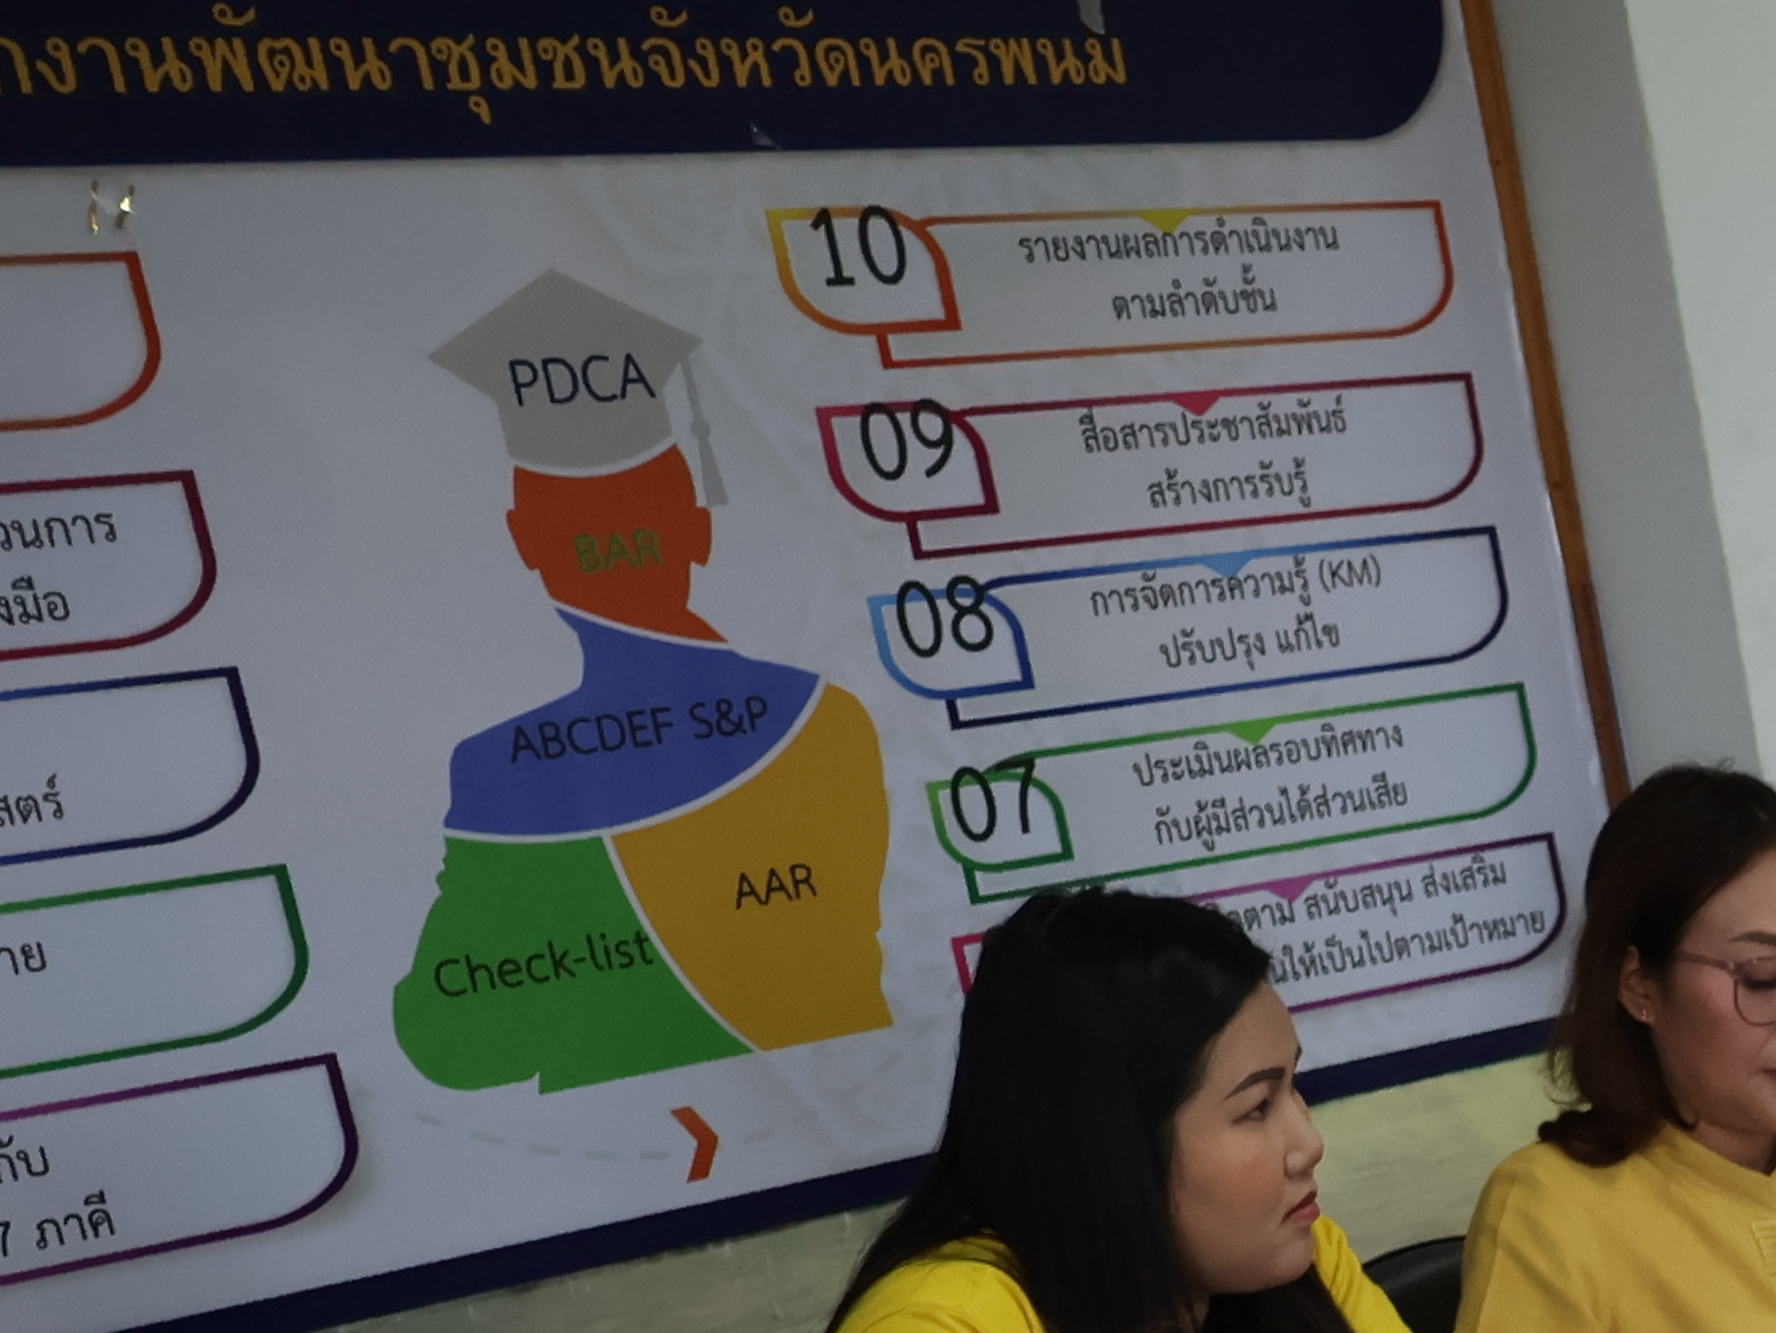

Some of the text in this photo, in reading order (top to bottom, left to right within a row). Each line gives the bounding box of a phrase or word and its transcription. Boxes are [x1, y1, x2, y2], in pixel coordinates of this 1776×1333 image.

[810, 205, 907, 288] 10
[1019, 222, 1339, 266] รายงานผลการดำเนินงาน
[1112, 262, 1278, 322] ตามลำดับชั้น
[508, 353, 656, 408] PDCA
[860, 399, 956, 482] 09
[1082, 397, 1348, 455] สื่อสารประชาสัมพันธ์
[1149, 457, 1312, 509] สร้างการรับรู้
[574, 528, 663, 574] BAR
[896, 575, 994, 660] 08
[1090, 554, 1381, 619] การจัดการความรู้ (KM)
[1160, 616, 1340, 673] ปรับปรุง แก้ไข
[510, 695, 769, 765] ABCDEF S&P
[1133, 720, 1404, 790] ประเมินผลรอบทิศทาง
[950, 757, 1038, 843] 07
[1154, 776, 1409, 852] กับผู้มีส่วนได้ส่วนเสีย
[735, 864, 817, 910] AAR
[1305, 877, 1413, 921] สนับสนุน
[1421, 853, 1507, 900] ส่งเสริม
[434, 930, 654, 999] Check-list
[36, 1190, 116, 1250] ภาคี
